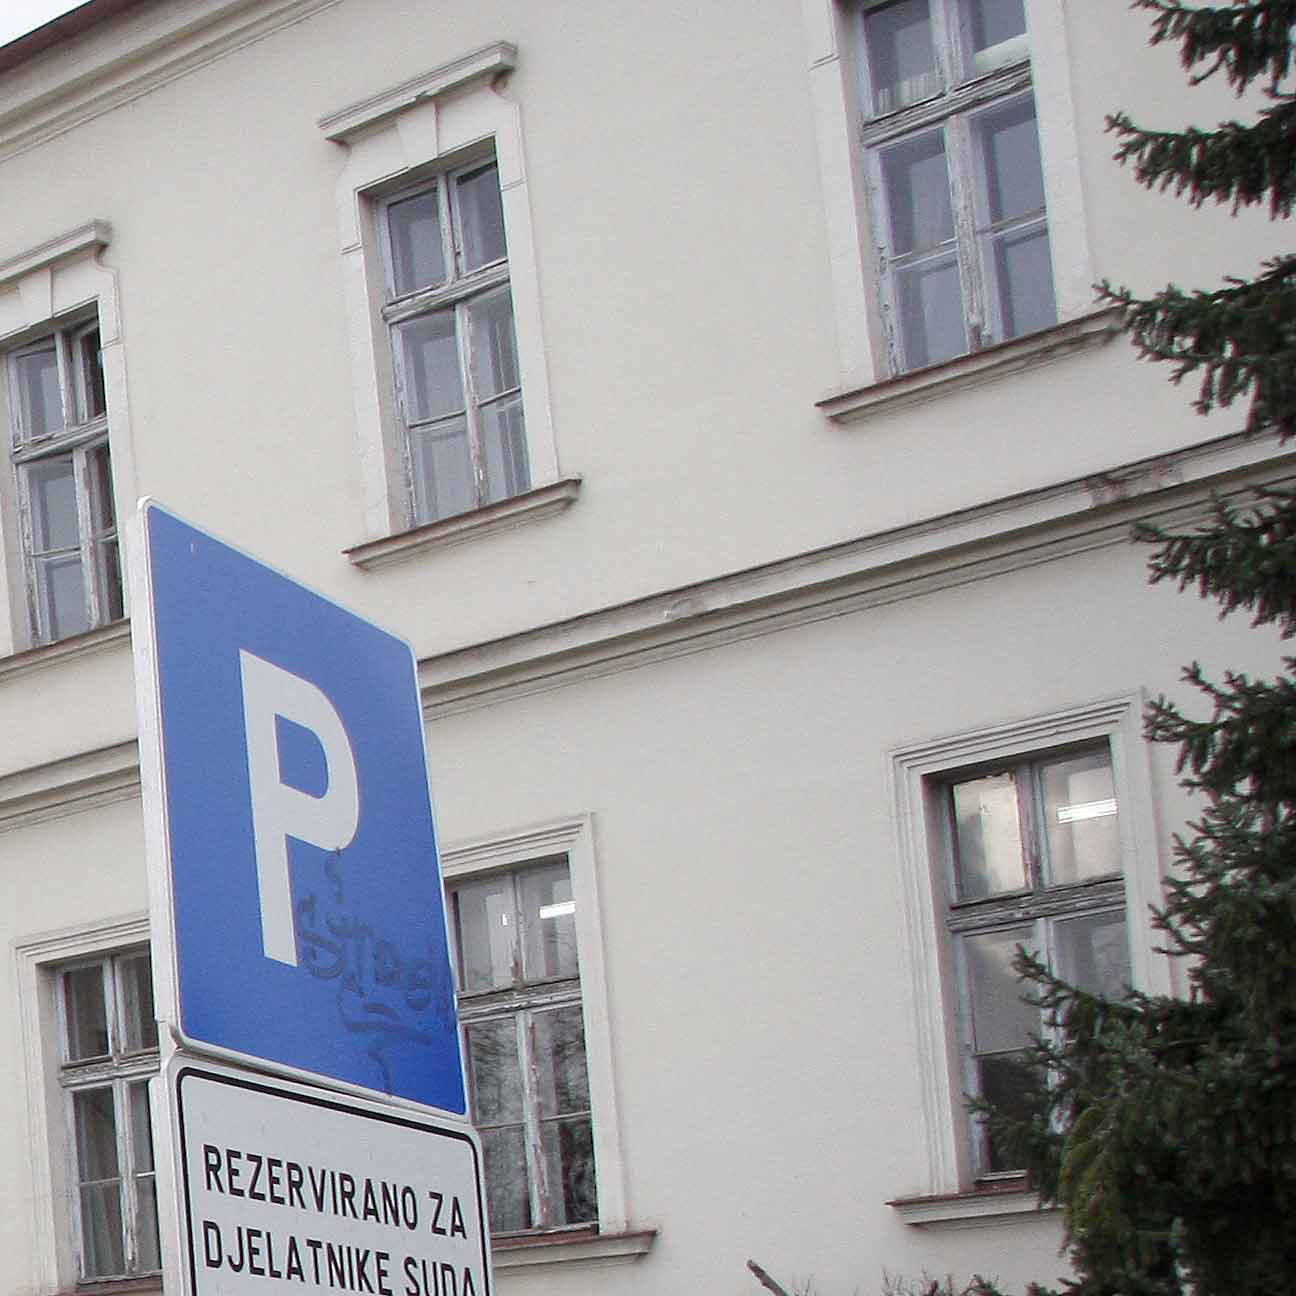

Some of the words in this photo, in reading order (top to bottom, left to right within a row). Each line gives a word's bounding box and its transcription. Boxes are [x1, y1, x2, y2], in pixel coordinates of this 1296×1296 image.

[239, 647, 359, 967] P
[203, 1143, 418, 1231] REZERVIRANO
[428, 1191, 467, 1239] ZA
[203, 1220, 393, 1296] DJELATNIKE
